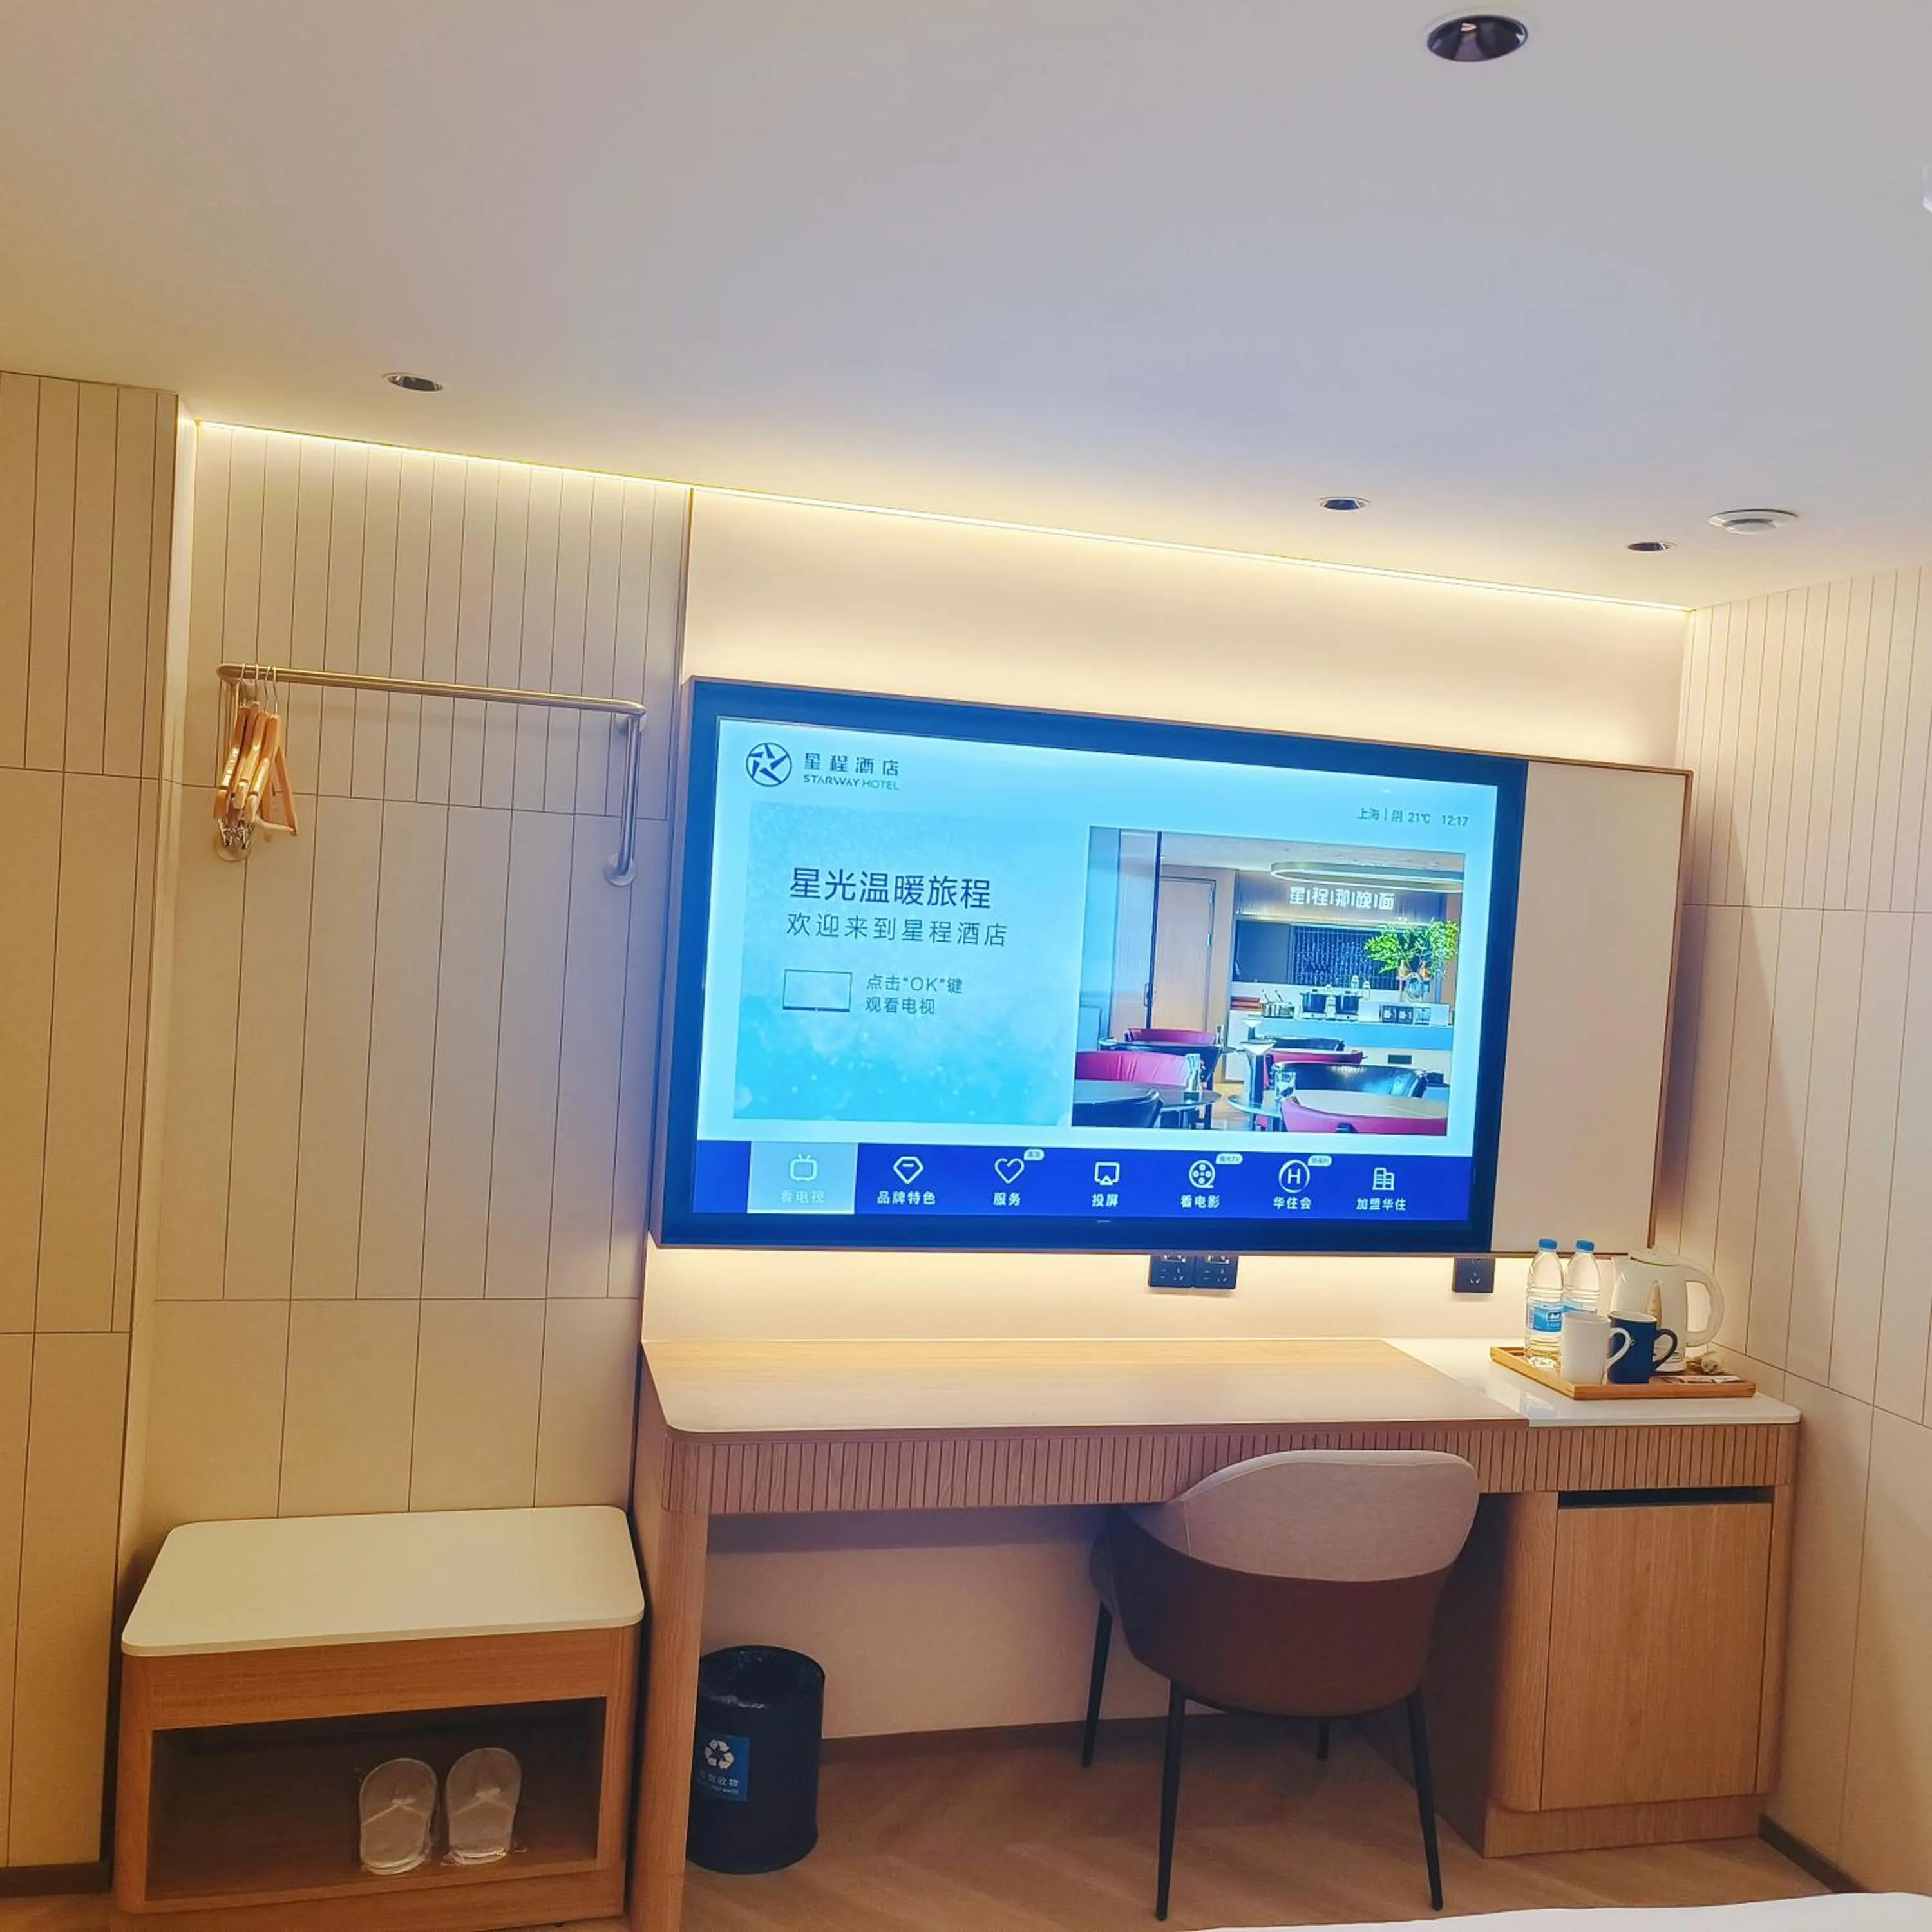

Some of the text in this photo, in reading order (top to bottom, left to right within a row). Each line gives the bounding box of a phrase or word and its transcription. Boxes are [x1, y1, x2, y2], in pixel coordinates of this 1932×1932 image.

[804, 752, 899, 777] 星程酒店
[803, 773, 900, 791] STARWAY HOTEL
[1442, 815, 1469, 827] 12:17
[789, 867, 991, 910] 星光温暖旅程
[786, 911, 1007, 947] 欢迎来到星程酒店
[865, 996, 935, 1015] 观看电视
[780, 1190, 825, 1204] 看电视
[876, 1190, 936, 1205] 品牌特色
[993, 1191, 1021, 1207] 服务
[1092, 1193, 1119, 1208] 投屏
[1180, 1195, 1221, 1209] 看电影
[1273, 1197, 1312, 1210] 华住会
[1356, 1197, 1406, 1212] 加盟华住
